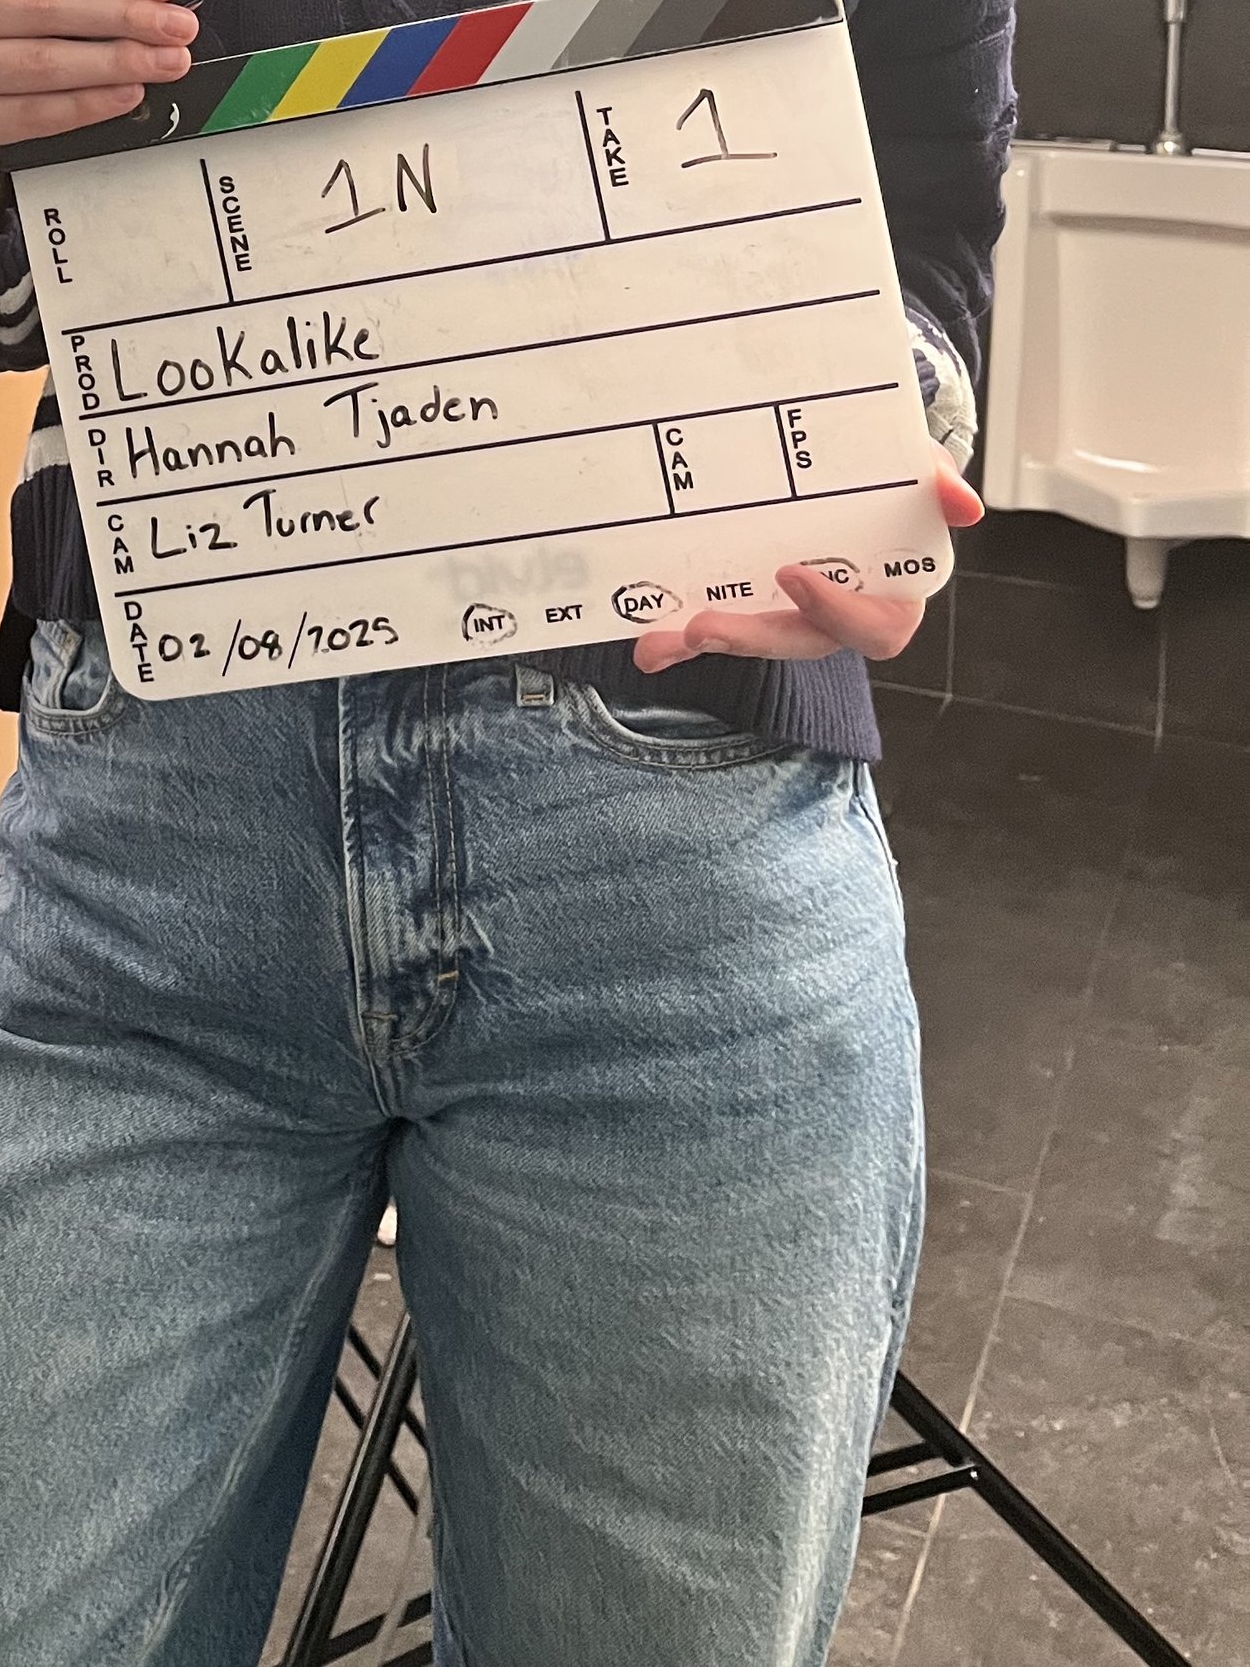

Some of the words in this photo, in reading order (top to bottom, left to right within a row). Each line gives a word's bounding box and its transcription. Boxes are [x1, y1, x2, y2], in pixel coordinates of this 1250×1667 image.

[595, 107, 629, 189] TAKE
[676, 88, 778, 169] 1
[43, 208, 73, 283] ROLL
[218, 176, 252, 272] SCENE
[71, 335, 101, 411] PROD
[88, 428, 116, 487] DIR
[125, 413, 297, 479] Hannah
[322, 380, 499, 448] Tjaden
[666, 428, 695, 490] CAM
[786, 409, 813, 470] FPS
[107, 514, 134, 575] CAM
[150, 518, 238, 559] Liz
[243, 488, 381, 538] Turner
[473, 612, 506, 634] INT
[545, 603, 583, 624] EXT
[624, 592, 664, 614] DAY
[706, 581, 755, 602] NITE
[883, 556, 937, 578] MOS
[124, 601, 155, 683] DATE
